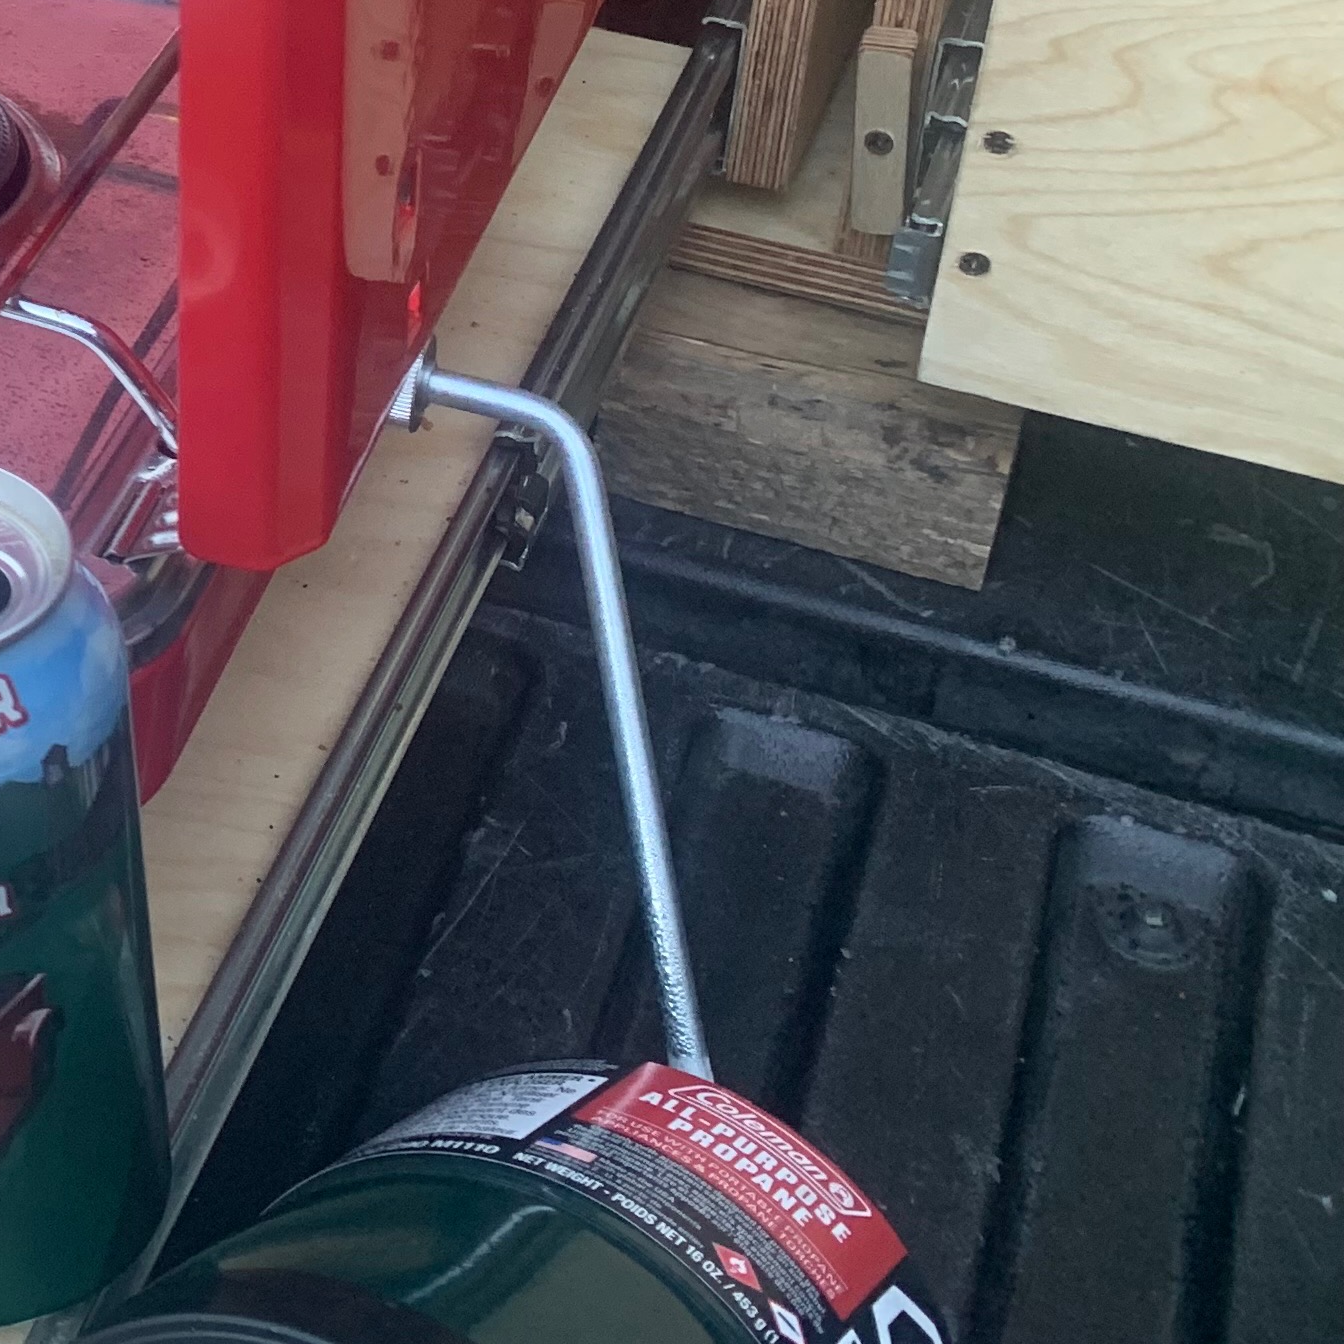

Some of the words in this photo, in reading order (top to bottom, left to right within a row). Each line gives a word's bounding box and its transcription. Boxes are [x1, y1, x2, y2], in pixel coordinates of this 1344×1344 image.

[590, 1115, 693, 1167] APPLIANCES
[708, 1172, 778, 1231] PROPANE
[639, 1091, 852, 1244] ALL-PURPOSE
[667, 1117, 813, 1227] PROPANE
[688, 1091, 829, 1181] Coleman
[512, 1152, 547, 1166] NET
[544, 1160, 605, 1191] WEIGHT
[611, 1192, 658, 1225] POIDS
[655, 1221, 687, 1246] NET
[685, 1244, 704, 1263] 16
[702, 1260, 724, 1284] OZ.
[732, 1291, 759, 1318] 453
[754, 1318, 767, 1331] g
[631, 1119, 660, 1137] USE
[663, 1135, 707, 1163] WITH
[708, 1161, 782, 1224] PORTABLE
[783, 1224, 846, 1295] PROPANE
